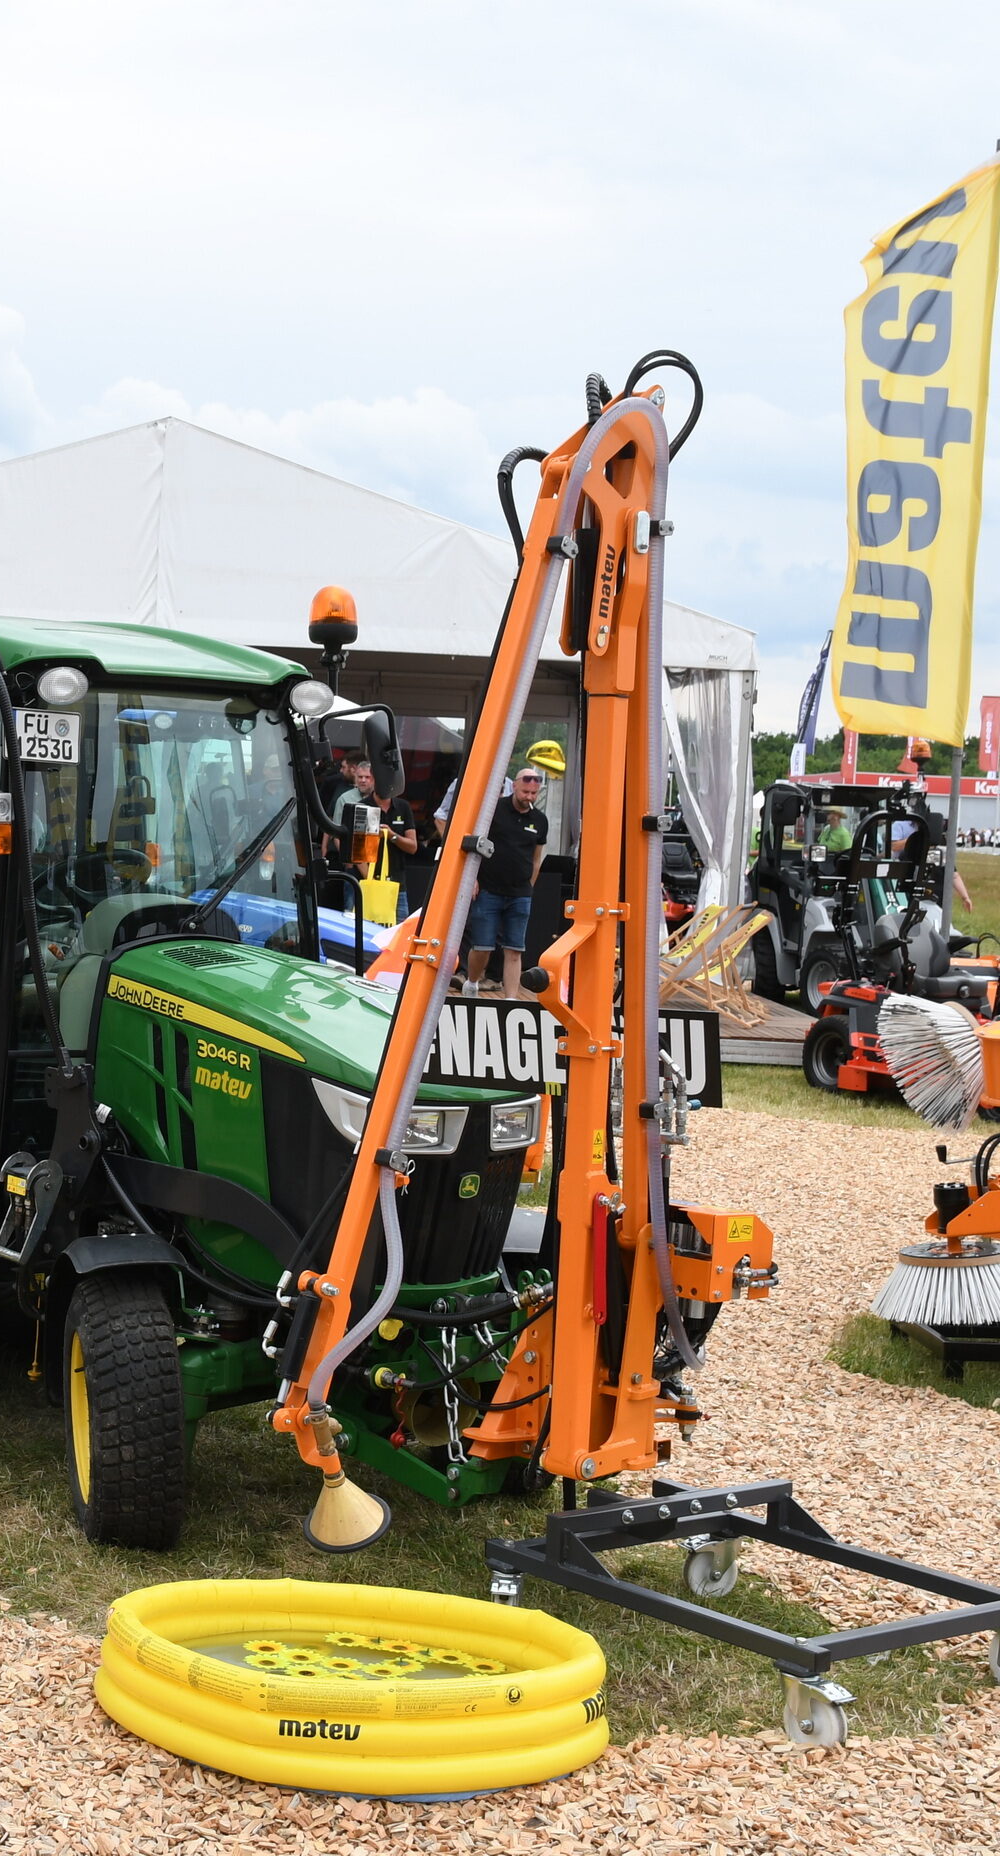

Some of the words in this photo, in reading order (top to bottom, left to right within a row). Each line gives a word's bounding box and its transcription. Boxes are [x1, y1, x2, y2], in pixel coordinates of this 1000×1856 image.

[598, 544, 616, 618] matev
[24, 713, 49, 735] FÜ
[111, 981, 143, 1006] JOHN
[143, 990, 185, 1018] DEERE
[196, 1039, 239, 1065] 3046
[239, 1052, 251, 1071] R
[195, 1066, 253, 1100] matev
[279, 1719, 361, 1742] matev
